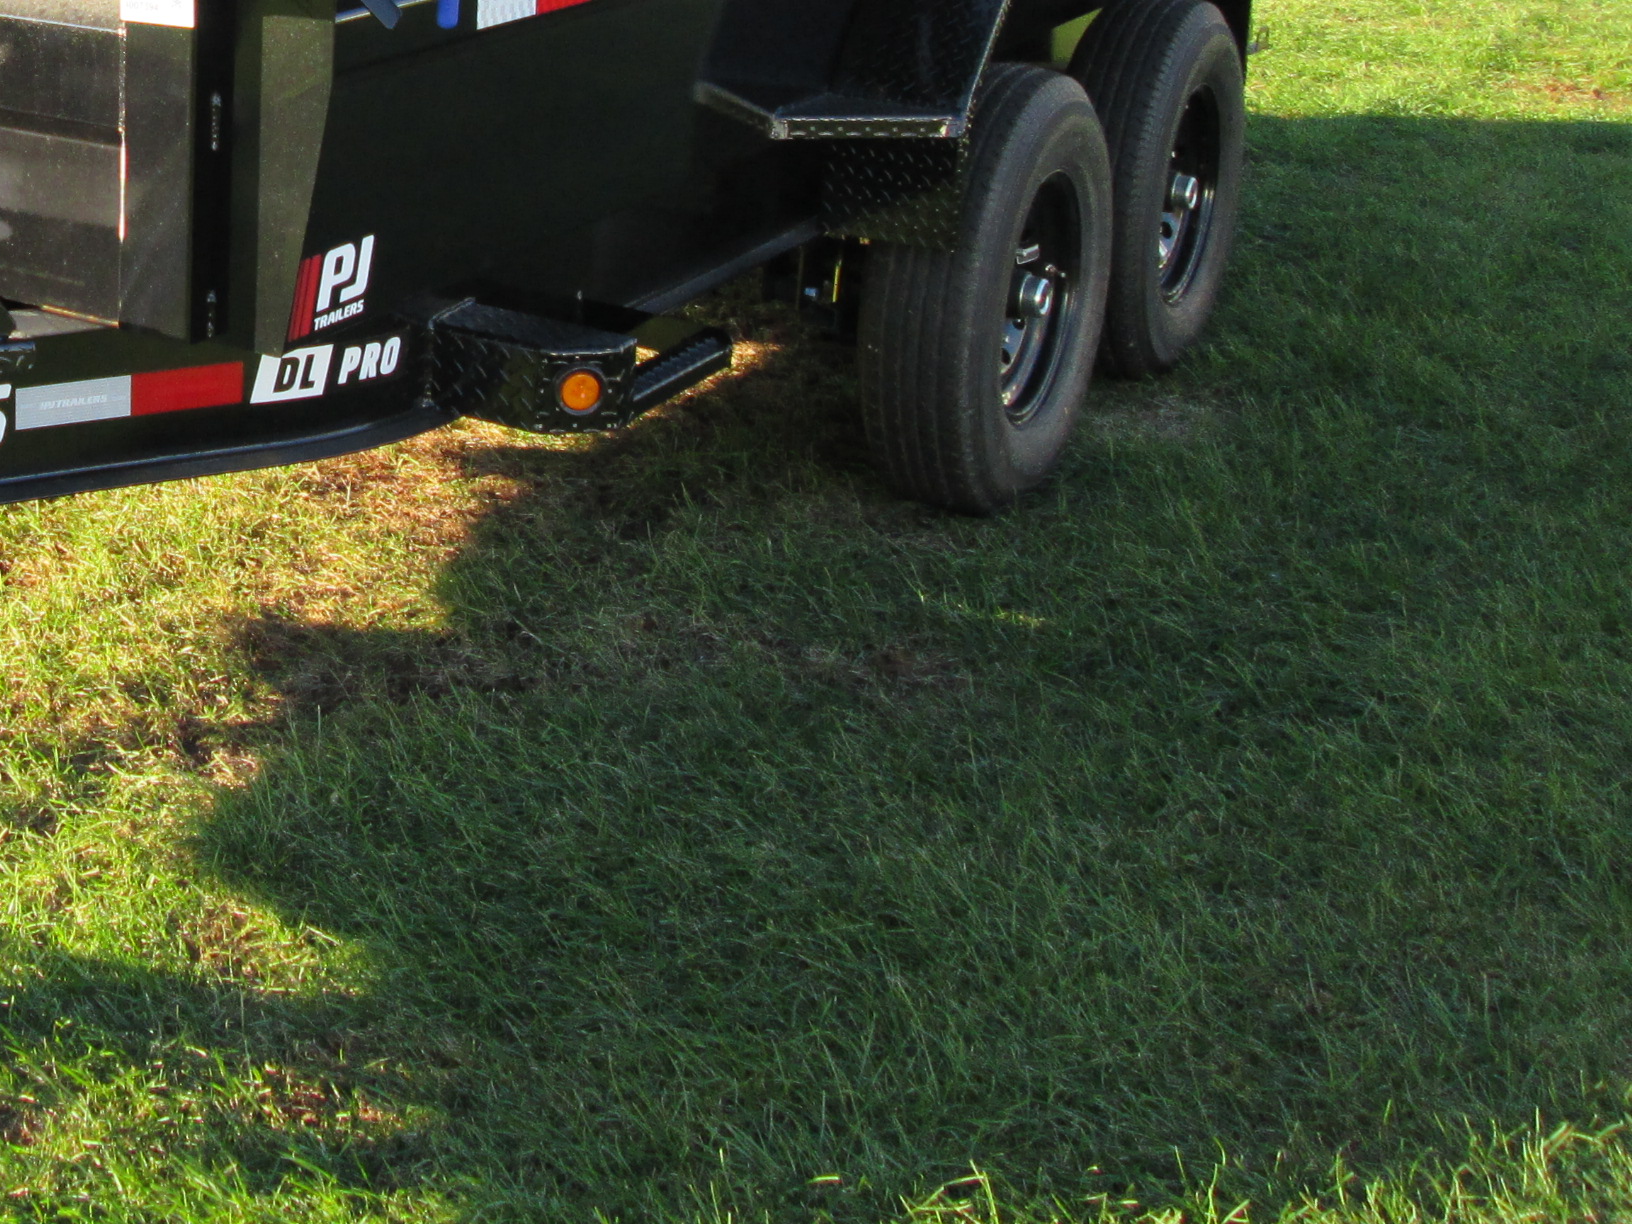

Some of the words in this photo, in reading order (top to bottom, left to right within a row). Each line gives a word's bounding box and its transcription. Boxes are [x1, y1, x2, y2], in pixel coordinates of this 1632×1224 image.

[316, 235, 375, 313] PJ
[314, 298, 365, 331] TRAILERS
[272, 353, 316, 394] DL
[337, 336, 401, 385] PRO
